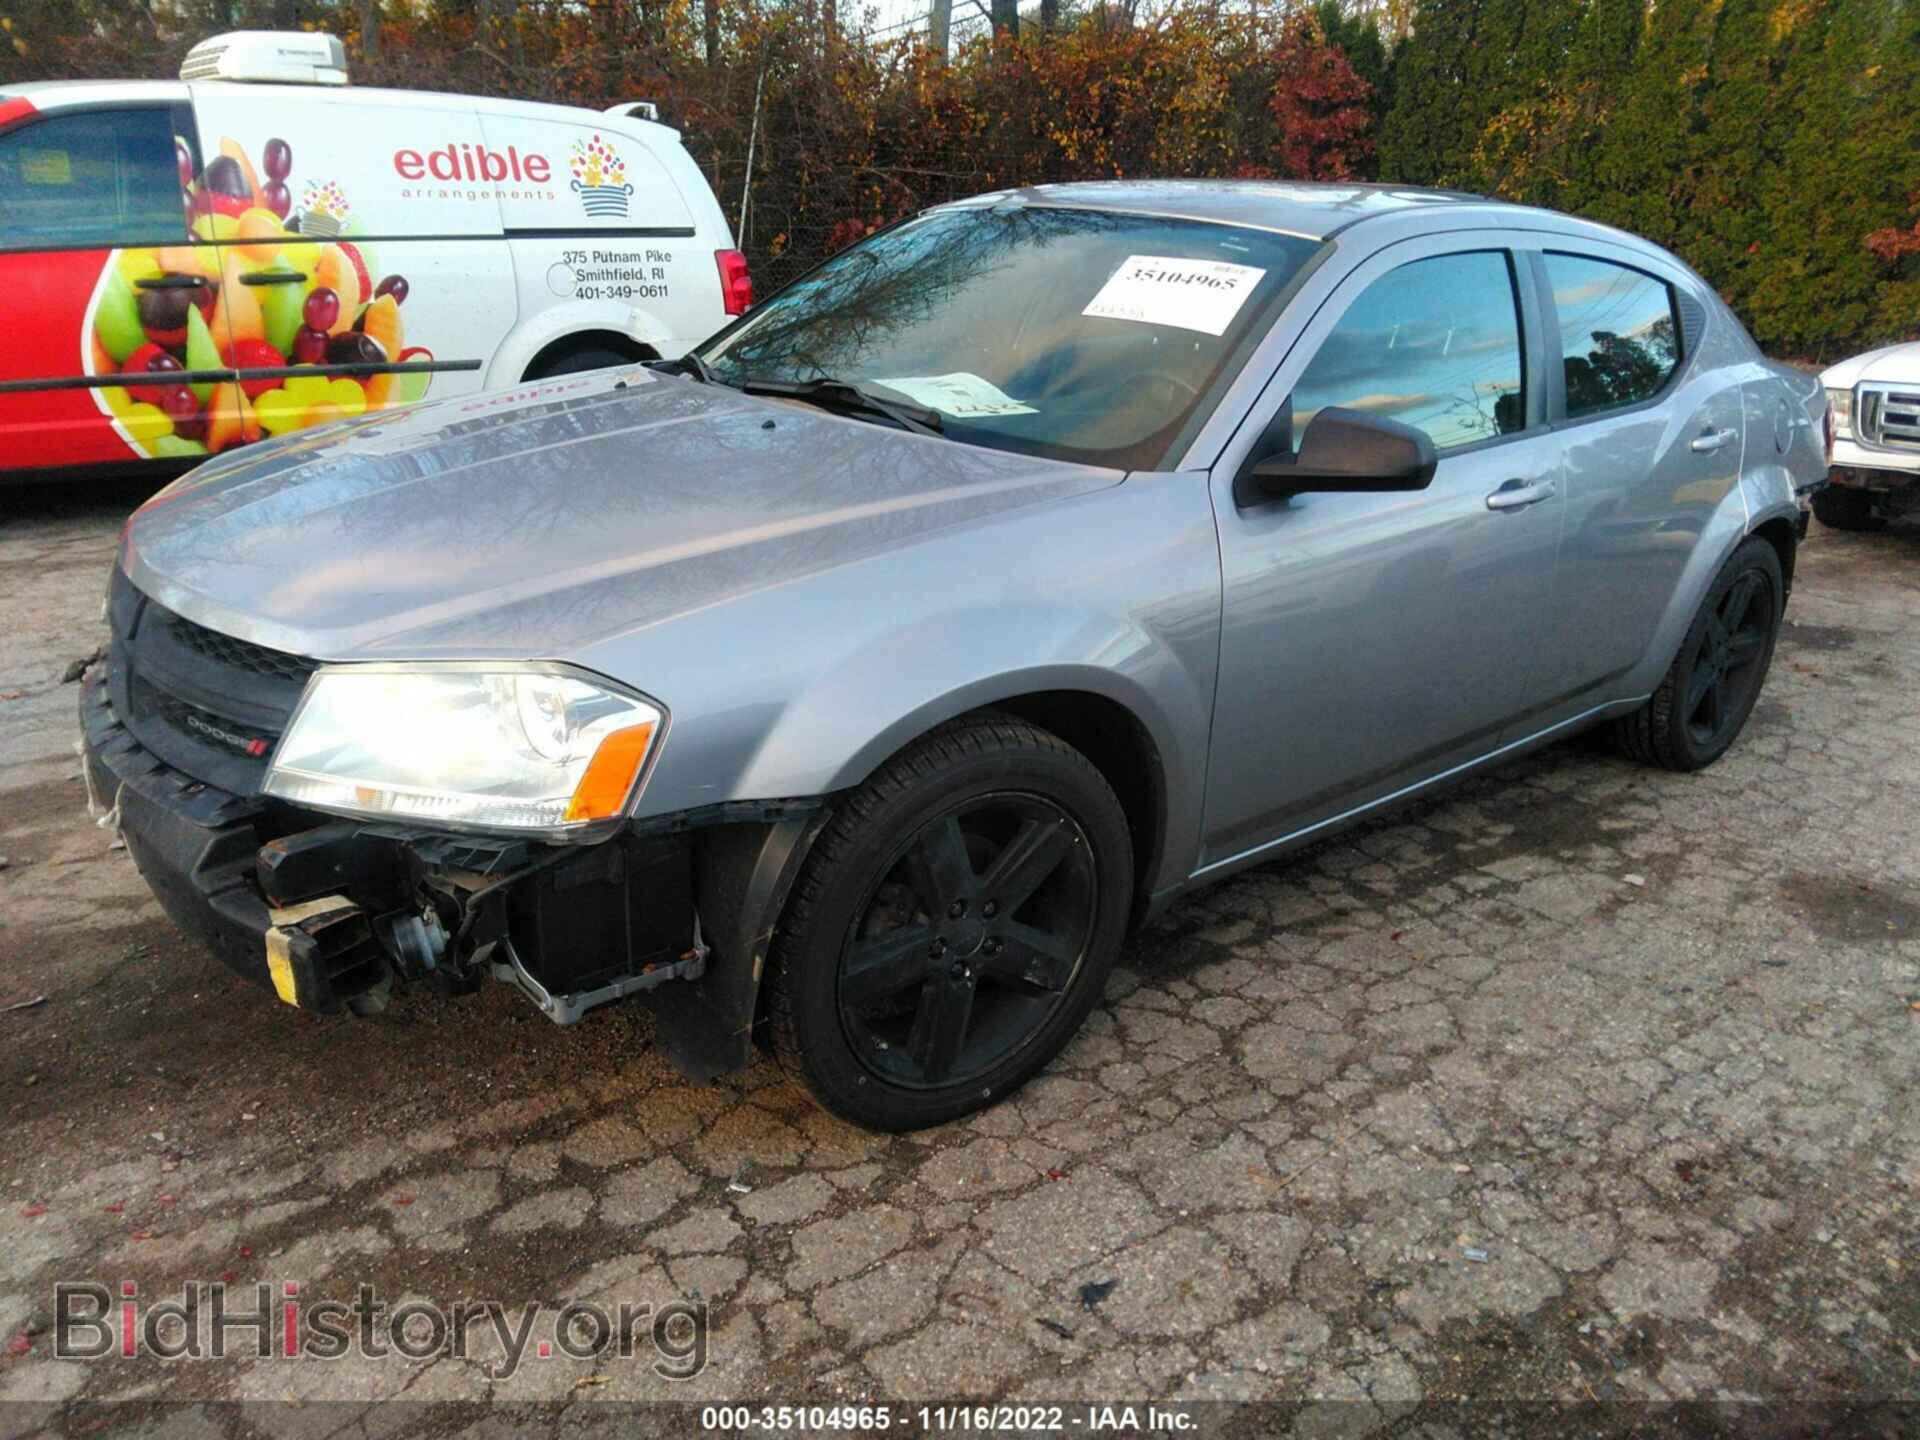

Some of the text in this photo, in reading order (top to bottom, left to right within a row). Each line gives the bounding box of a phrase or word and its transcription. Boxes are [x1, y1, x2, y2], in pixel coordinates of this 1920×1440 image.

[394, 143, 552, 183] edible
[402, 187, 555, 201] arrangements
[562, 249, 672, 265] 375 Putnam Pike
[576, 267, 665, 282] Smithfield, RI
[1126, 268, 1239, 291] 35104965
[575, 284, 668, 300] 401-349-0611
